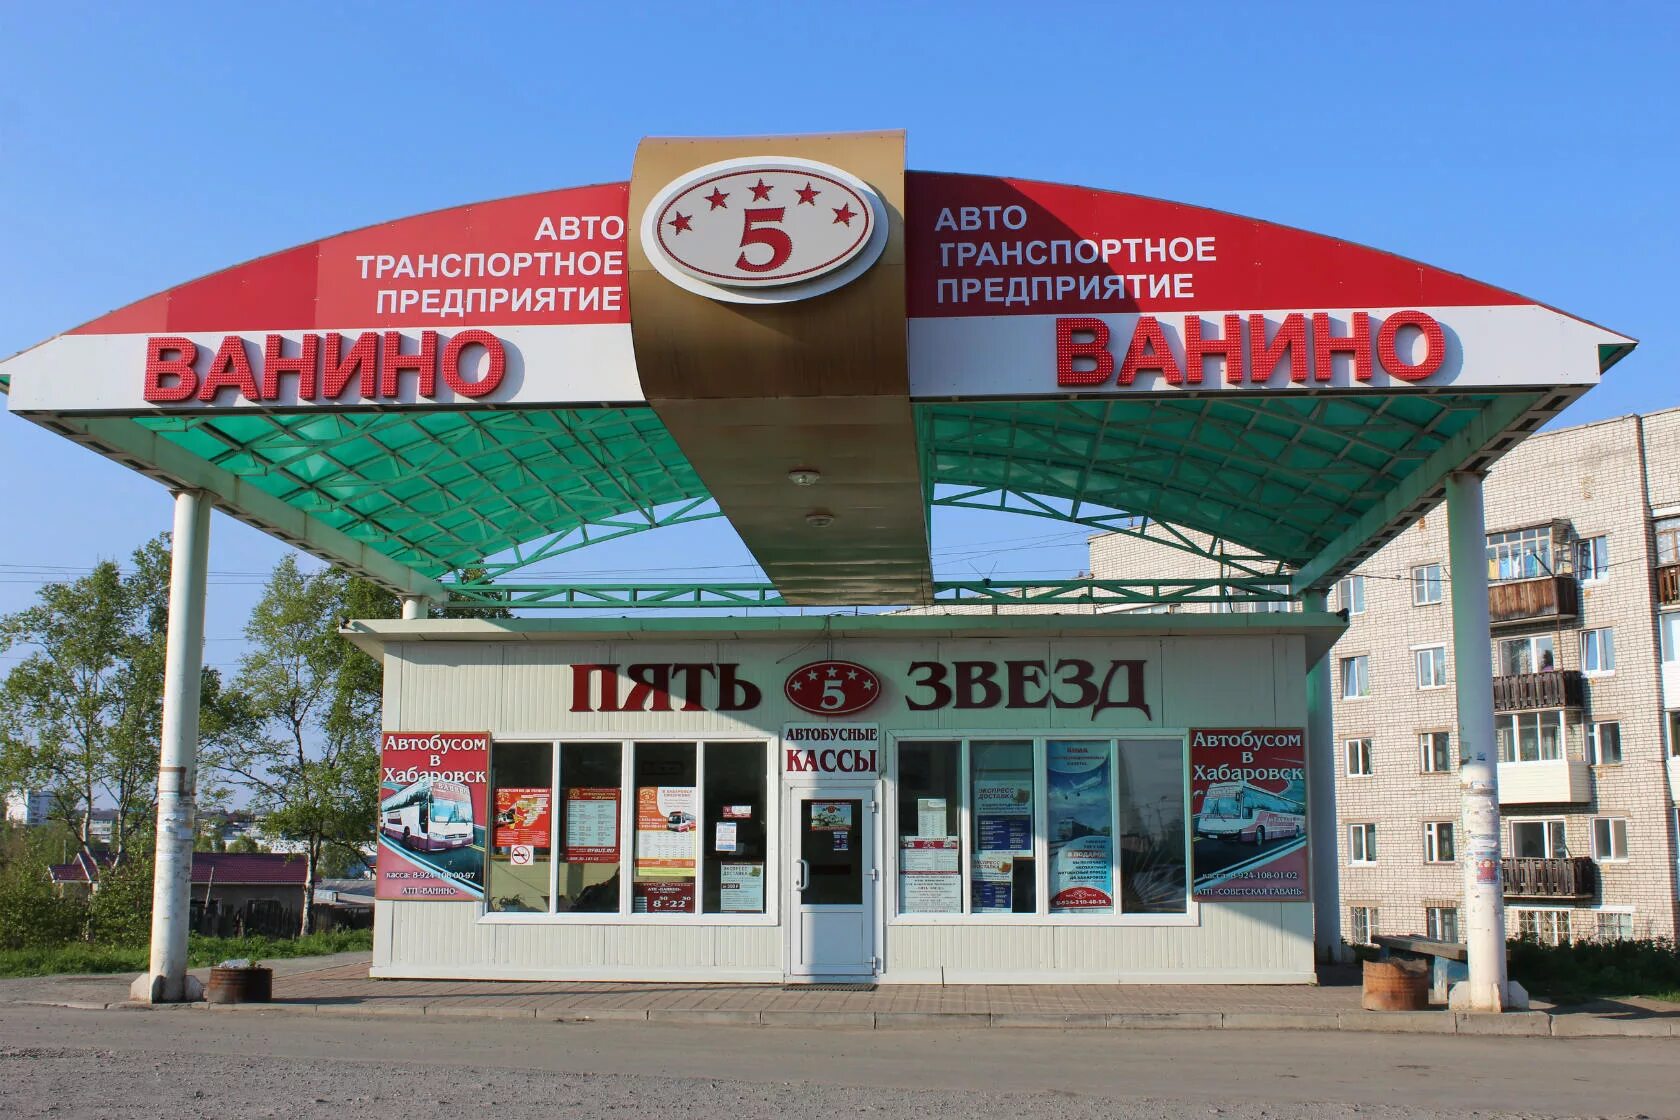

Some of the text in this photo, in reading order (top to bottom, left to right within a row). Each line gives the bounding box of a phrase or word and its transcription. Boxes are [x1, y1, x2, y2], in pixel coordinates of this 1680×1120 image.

[534, 216, 625, 241] АВТО
[934, 205, 1027, 231] АВТО
[735, 206, 793, 273] 5
[940, 237, 1217, 267] ТРАНСПОРТНОЕ
[356, 251, 623, 279] ТРАНСПОРТНОЕ
[376, 286, 622, 317] ПРЕДПРИЯТИЕ
[937, 273, 1195, 307] ПРЕДПРИЯТИЕ
[1055, 310, 1447, 387] ВАНИНО
[143, 329, 507, 402] ВАНИНО
[569, 658, 1152, 722] ПЯТЬ ЗВЕЗД
[820, 680, 846, 709] 5
[384, 735, 486, 754] Автобусом
[786, 728, 878, 741] АВТОБУСНЫЕ
[1192, 731, 1301, 751] Автобусом
[384, 766, 487, 783] Хабаровск
[786, 749, 878, 772] КАССЫ
[1193, 764, 1304, 781] Хабаровск
